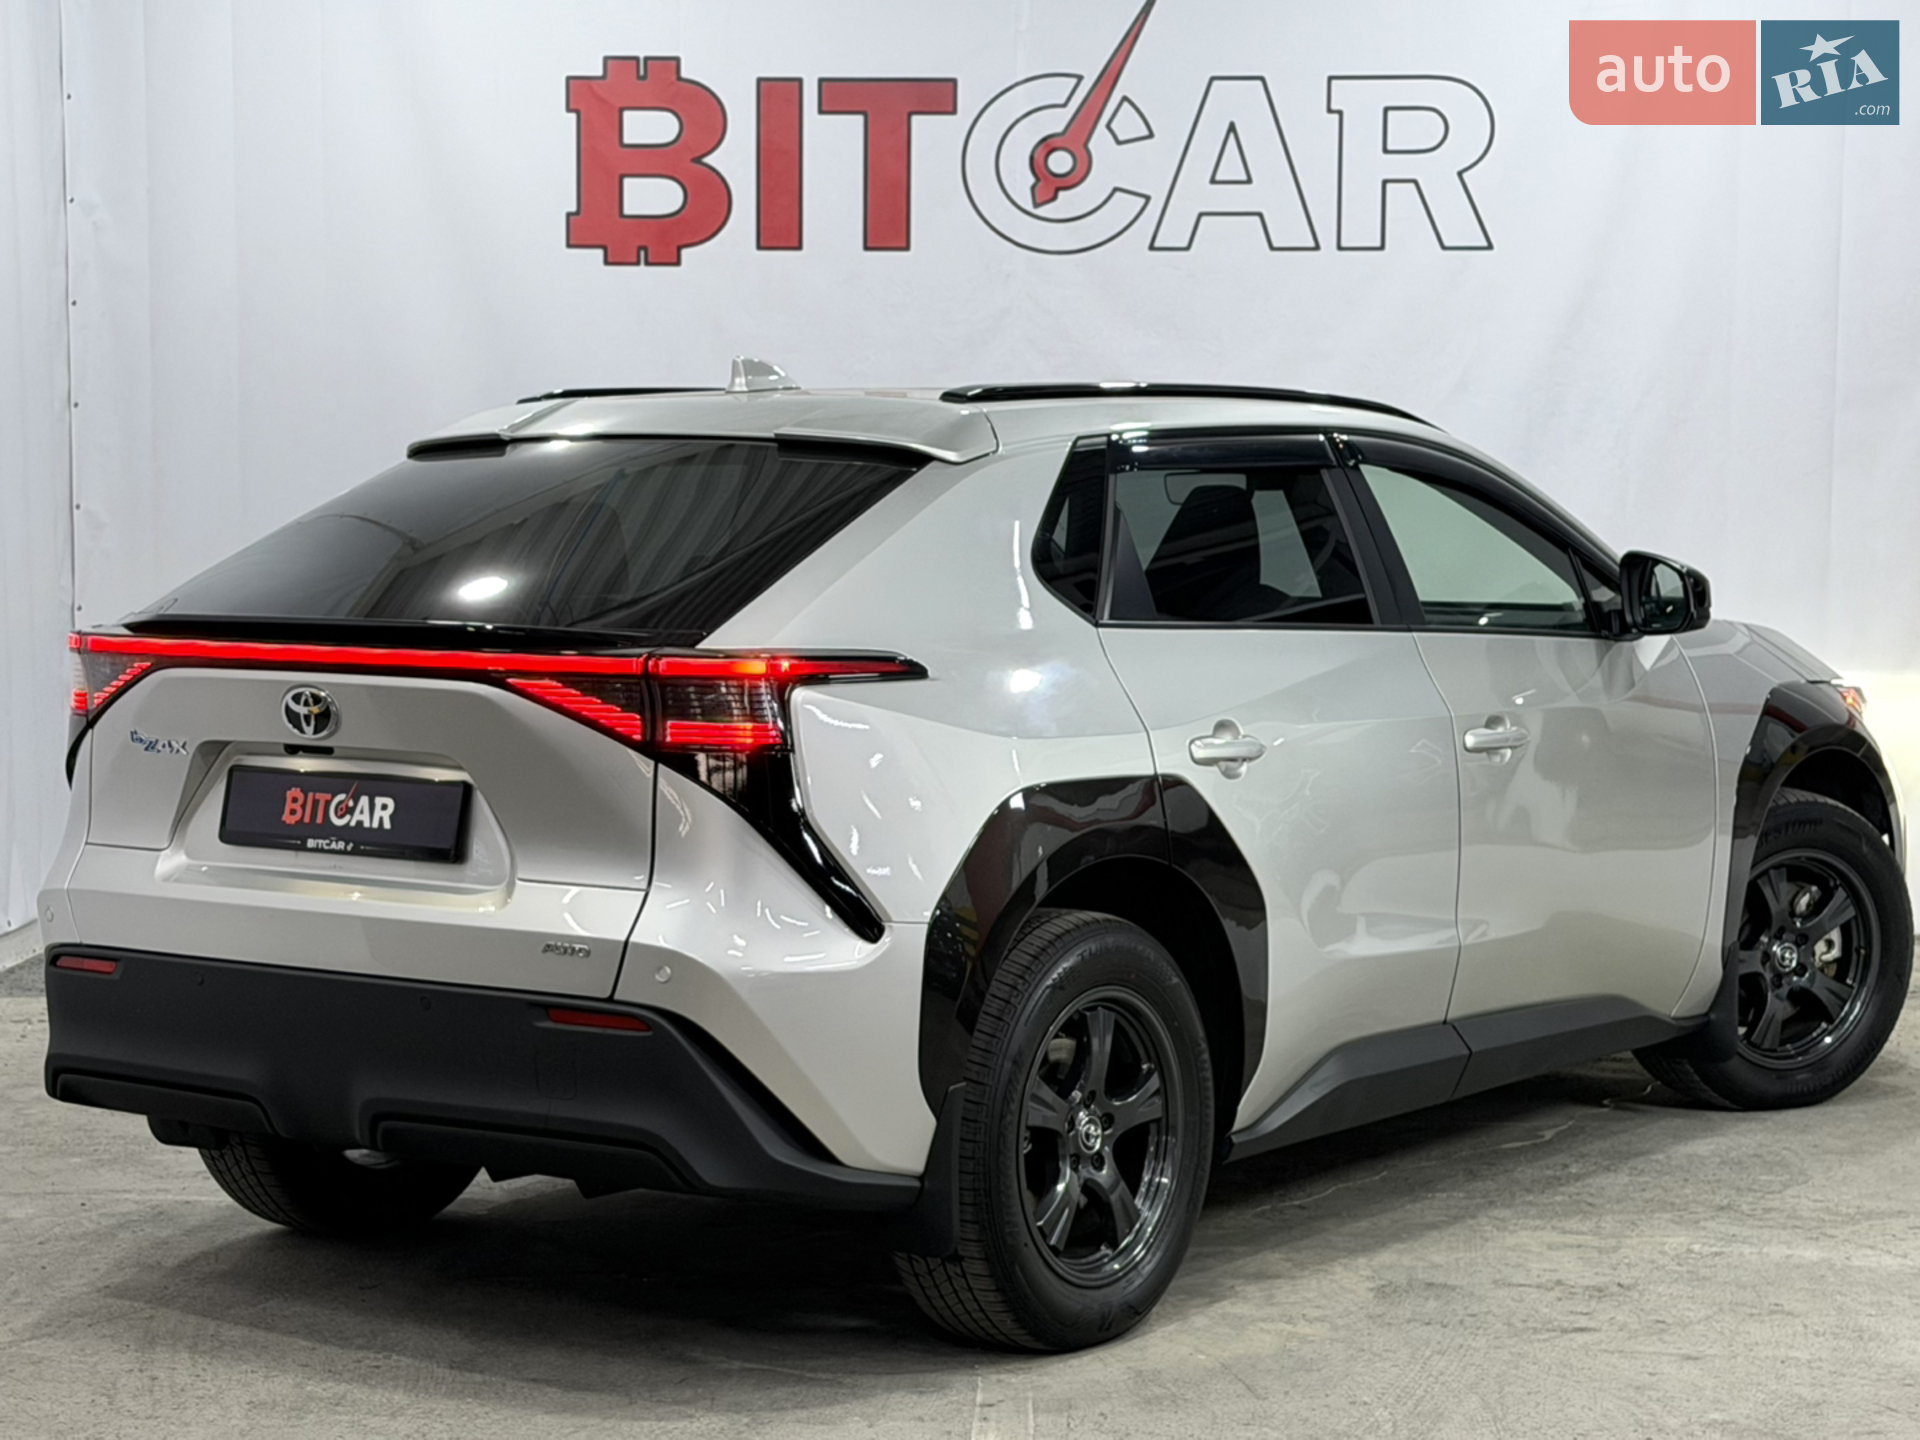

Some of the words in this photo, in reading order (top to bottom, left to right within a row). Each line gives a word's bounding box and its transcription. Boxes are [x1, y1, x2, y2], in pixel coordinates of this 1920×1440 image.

[565, 55, 1496, 267] BITCAR
[281, 786, 396, 830] BITCAR
[306, 837, 346, 851] BITCAR
